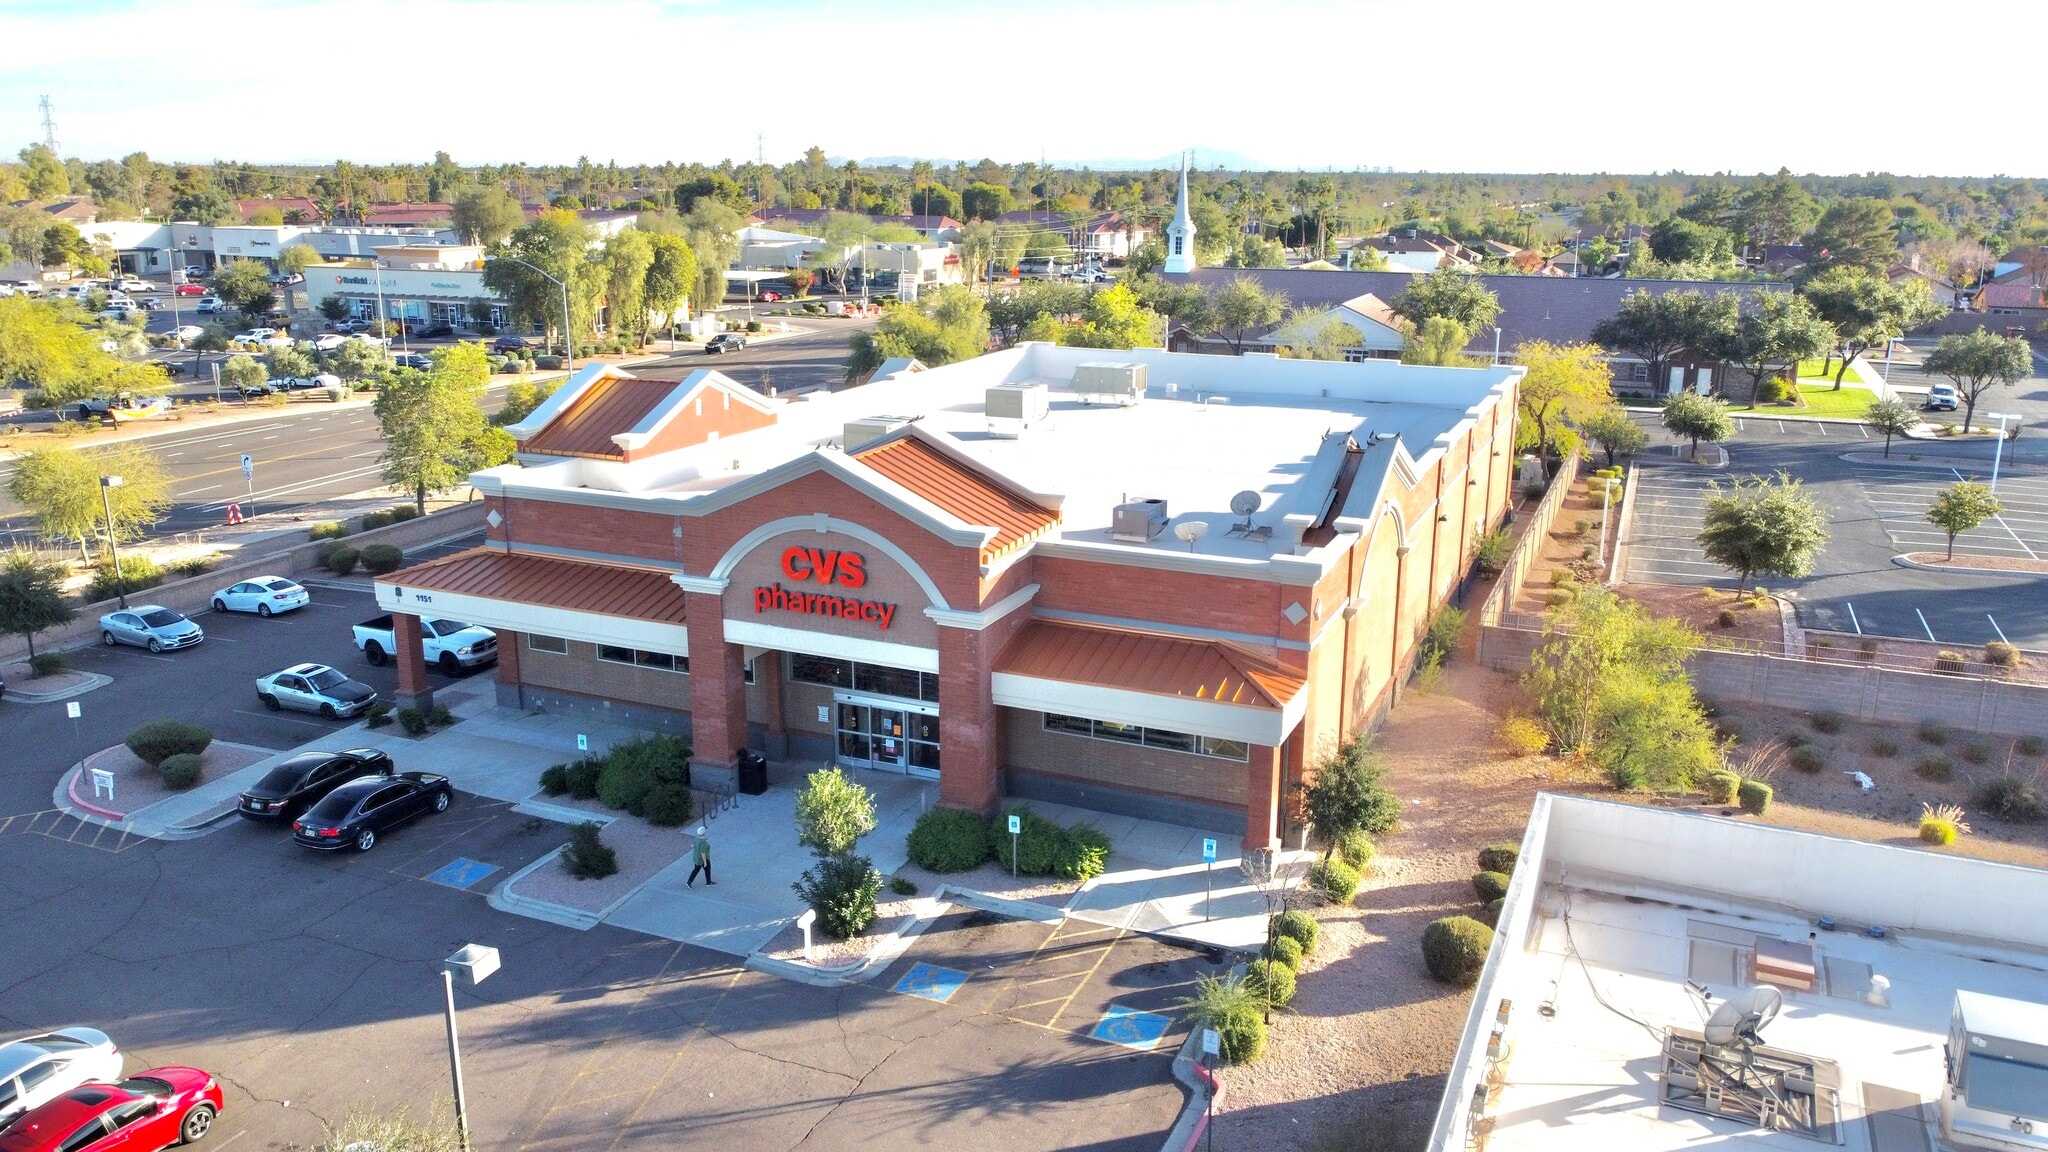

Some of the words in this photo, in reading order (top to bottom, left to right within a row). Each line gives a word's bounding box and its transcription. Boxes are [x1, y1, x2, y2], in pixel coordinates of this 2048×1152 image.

[781, 545, 866, 588] CVS
[416, 594, 432, 603] 1151
[754, 583, 897, 630] pharmacy
